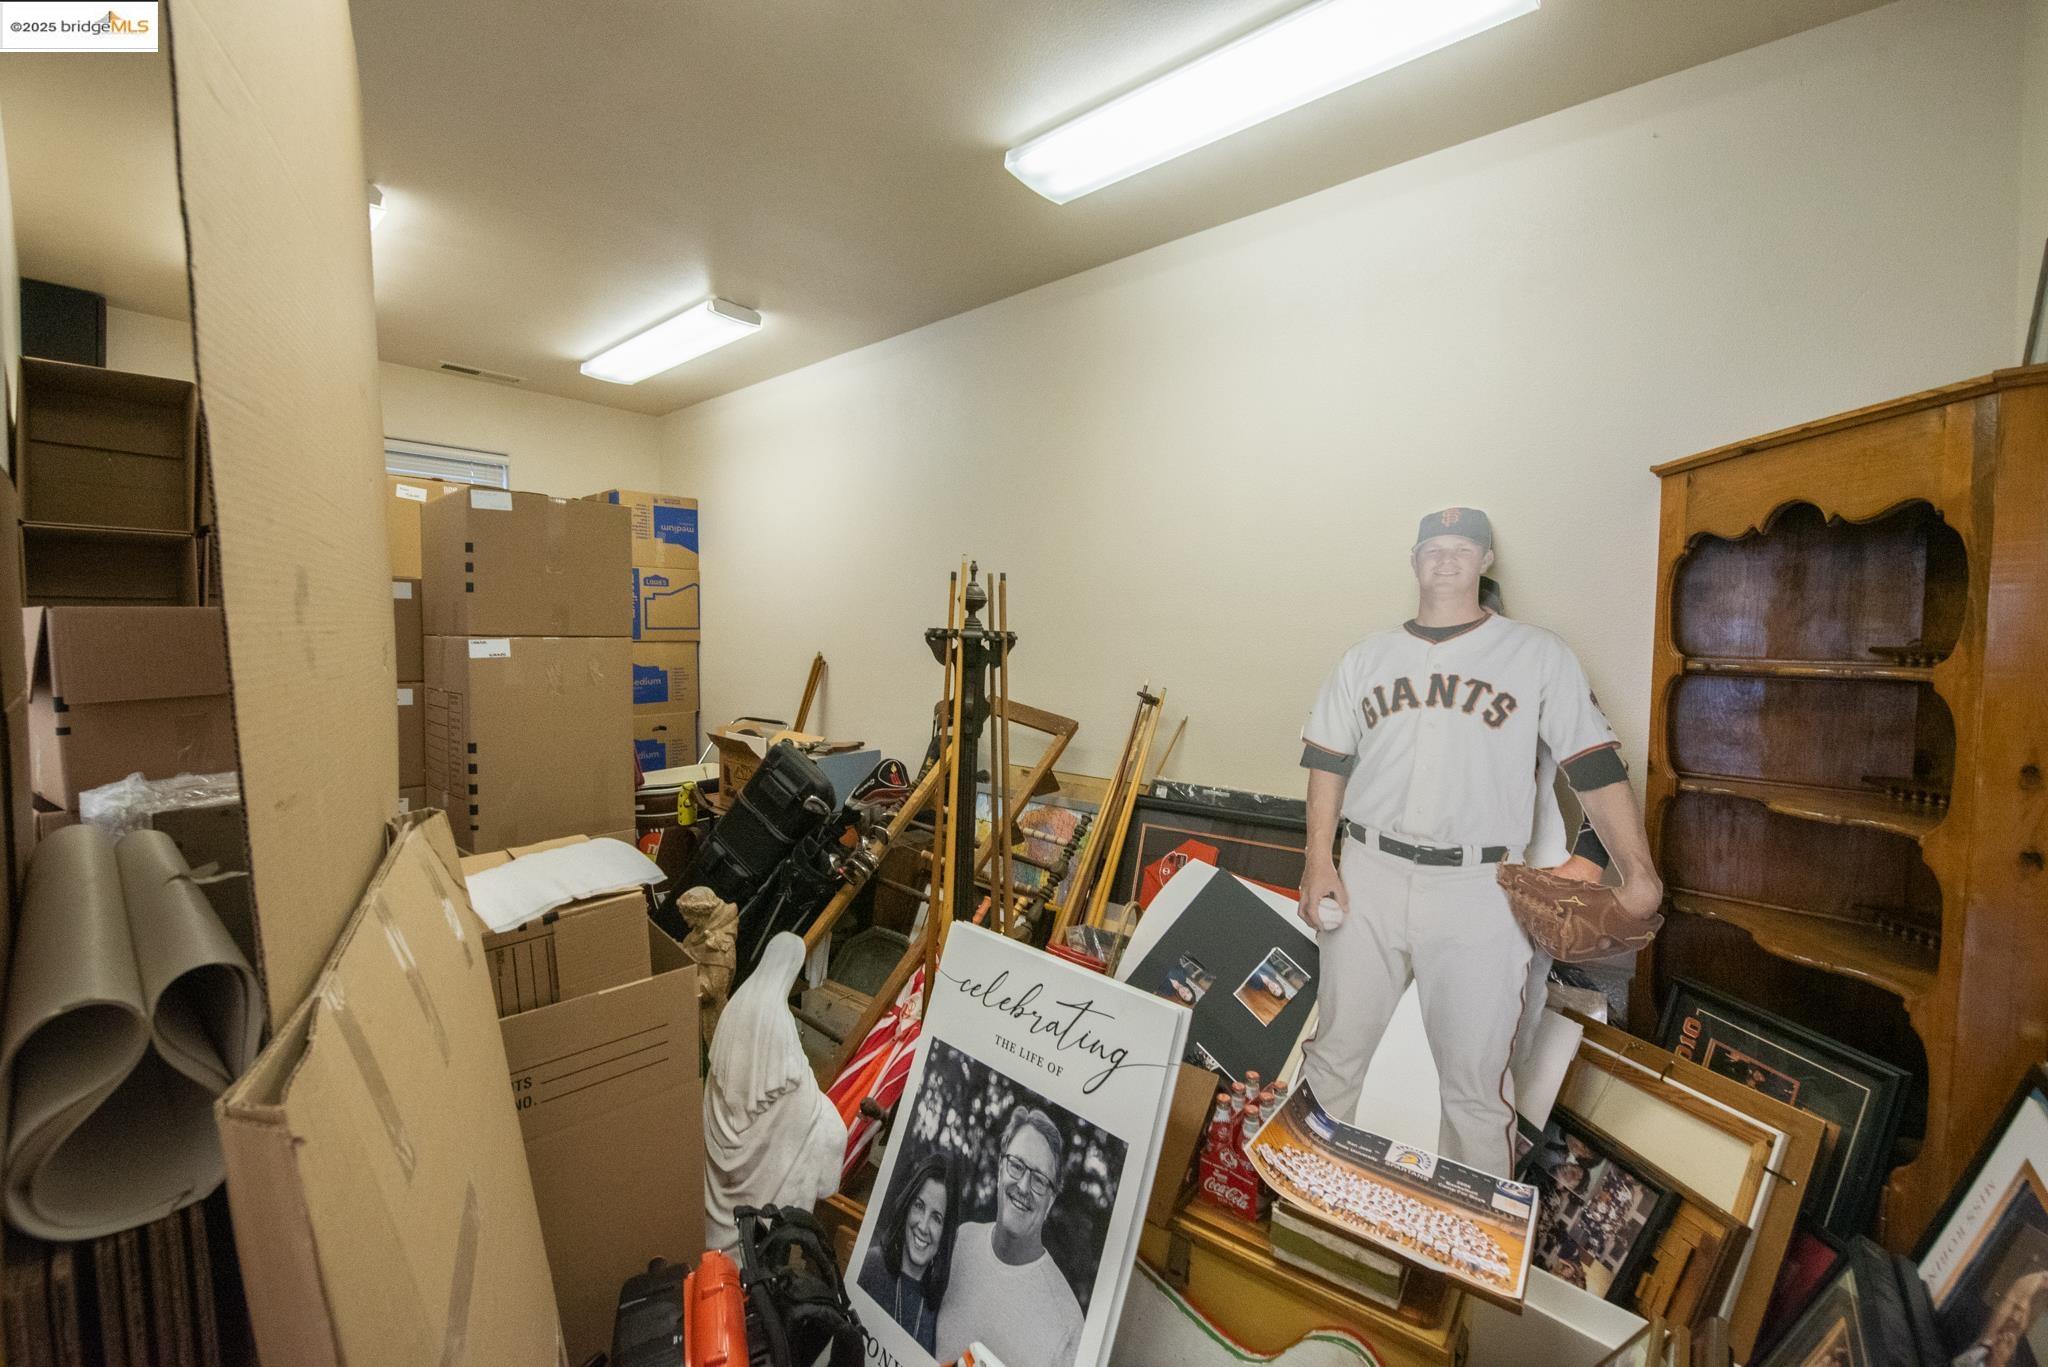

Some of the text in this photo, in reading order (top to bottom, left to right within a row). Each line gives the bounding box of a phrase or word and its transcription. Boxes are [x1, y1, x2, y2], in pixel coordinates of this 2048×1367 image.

[660, 524, 695, 534] medium
[634, 677, 662, 686] edium
[1360, 672, 1519, 731] GIANTS
[639, 751, 660, 760] dium
[950, 970, 1134, 1094] celebrating
[995, 1034, 1065, 1078] THE LIFE OF
[1384, 1160, 1430, 1183] SPARTANS
[1203, 1176, 1251, 1210] Coca-Cola
